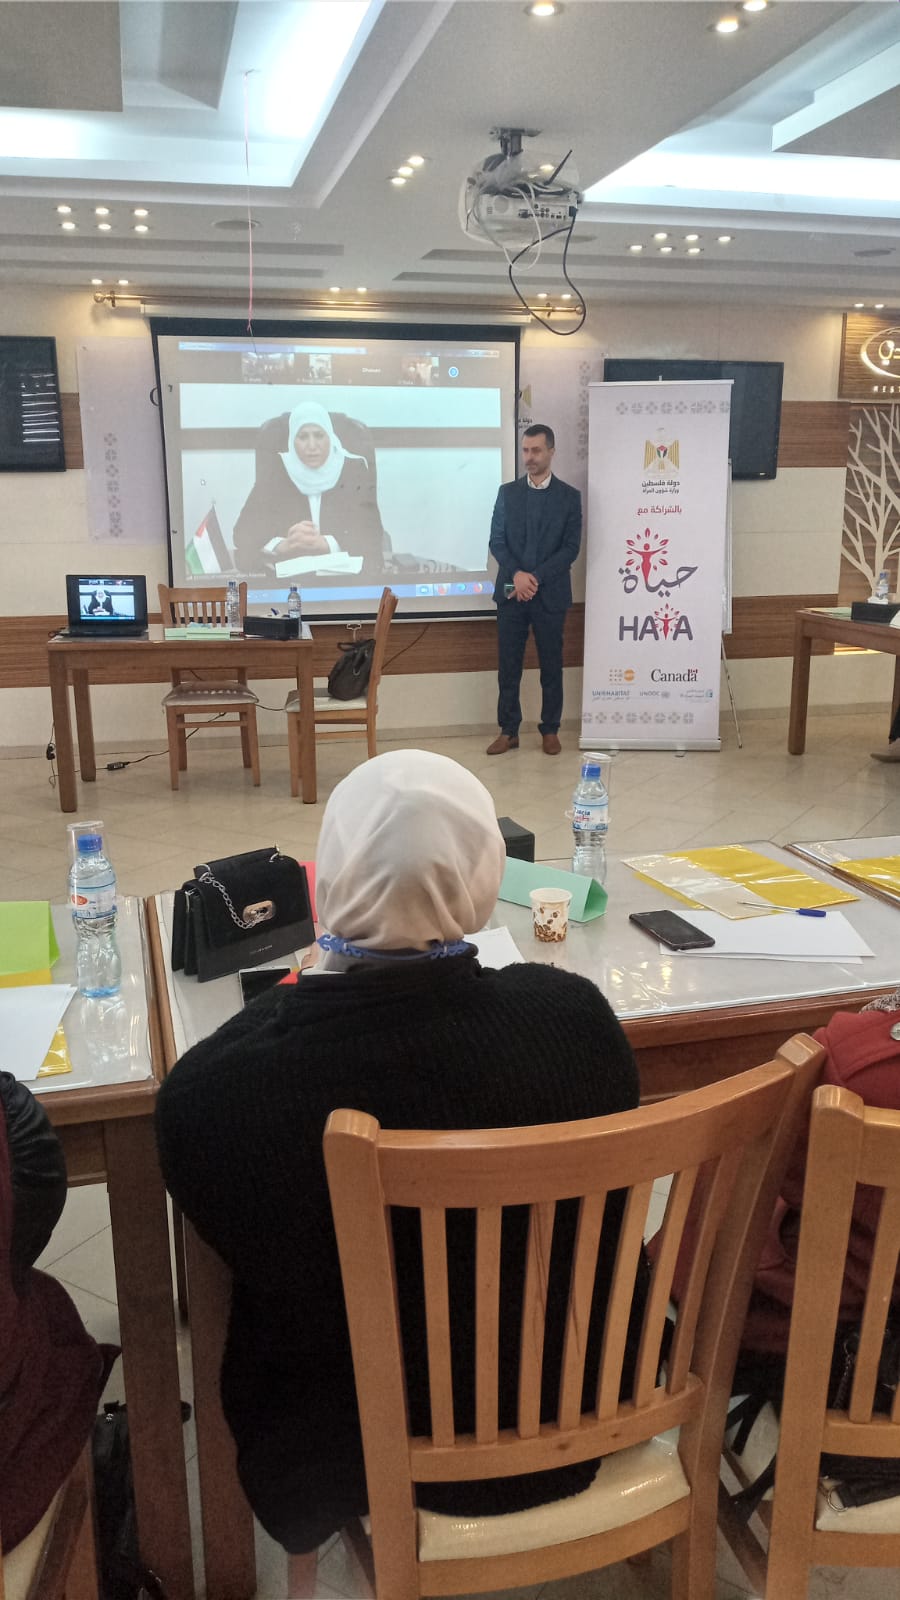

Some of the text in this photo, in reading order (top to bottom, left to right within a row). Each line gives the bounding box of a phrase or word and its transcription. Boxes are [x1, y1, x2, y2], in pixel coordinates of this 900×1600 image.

[641, 479, 681, 488] دولة فلسطين
[637, 504, 682, 516] بالشراكة مع
[618, 543, 699, 598] حياة
[650, 668, 699, 682] Canada
